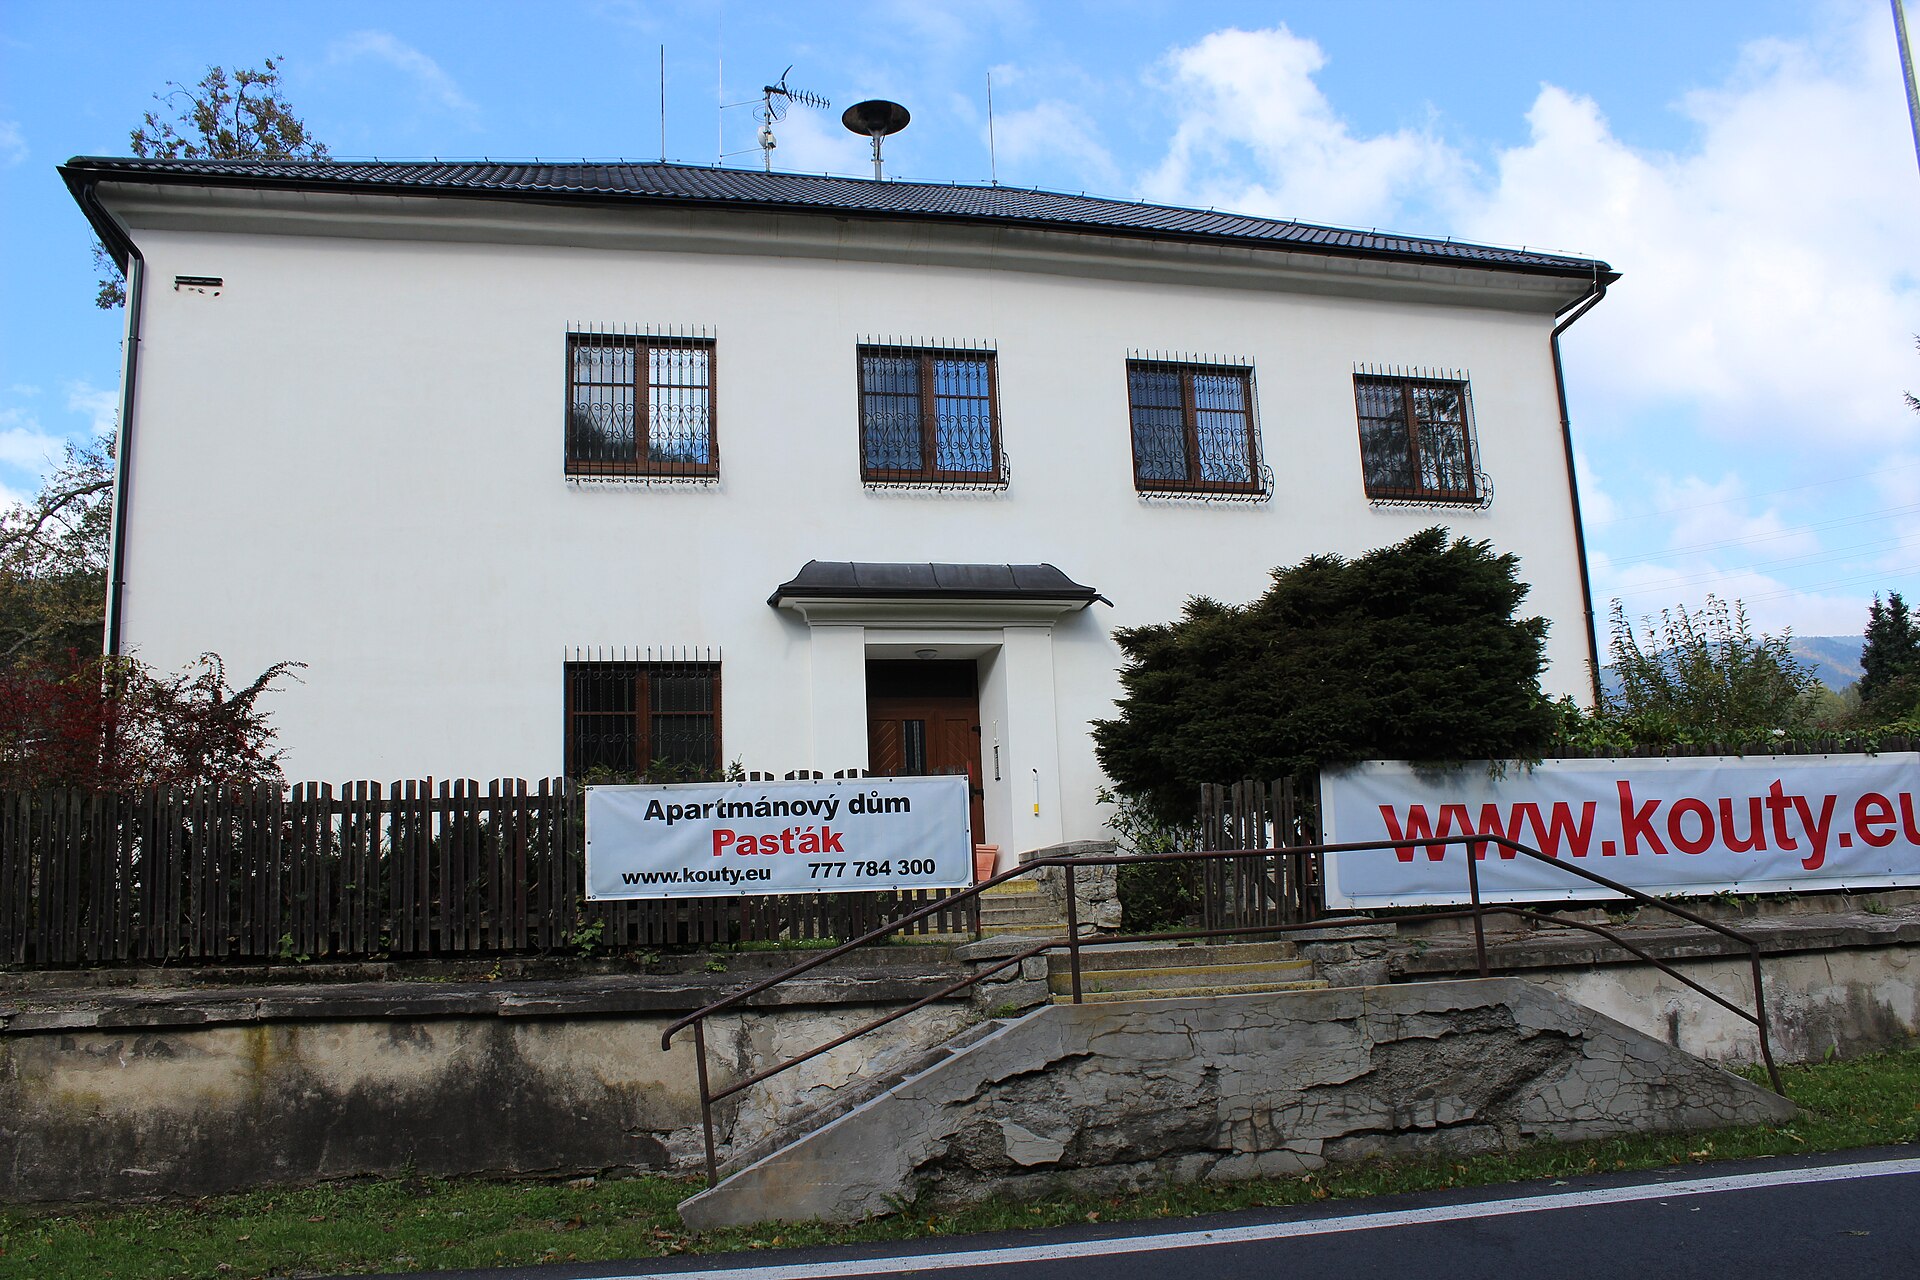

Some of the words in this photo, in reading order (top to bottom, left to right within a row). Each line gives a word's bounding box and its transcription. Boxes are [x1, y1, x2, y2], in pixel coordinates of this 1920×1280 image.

[643, 794, 840, 825] Apartmánový
[848, 790, 911, 815] dům
[713, 826, 844, 857] Pasťák
[622, 866, 771, 886] www.kouty.eu
[808, 861, 847, 879] 777
[853, 860, 892, 878] 784
[897, 859, 936, 876] 300
